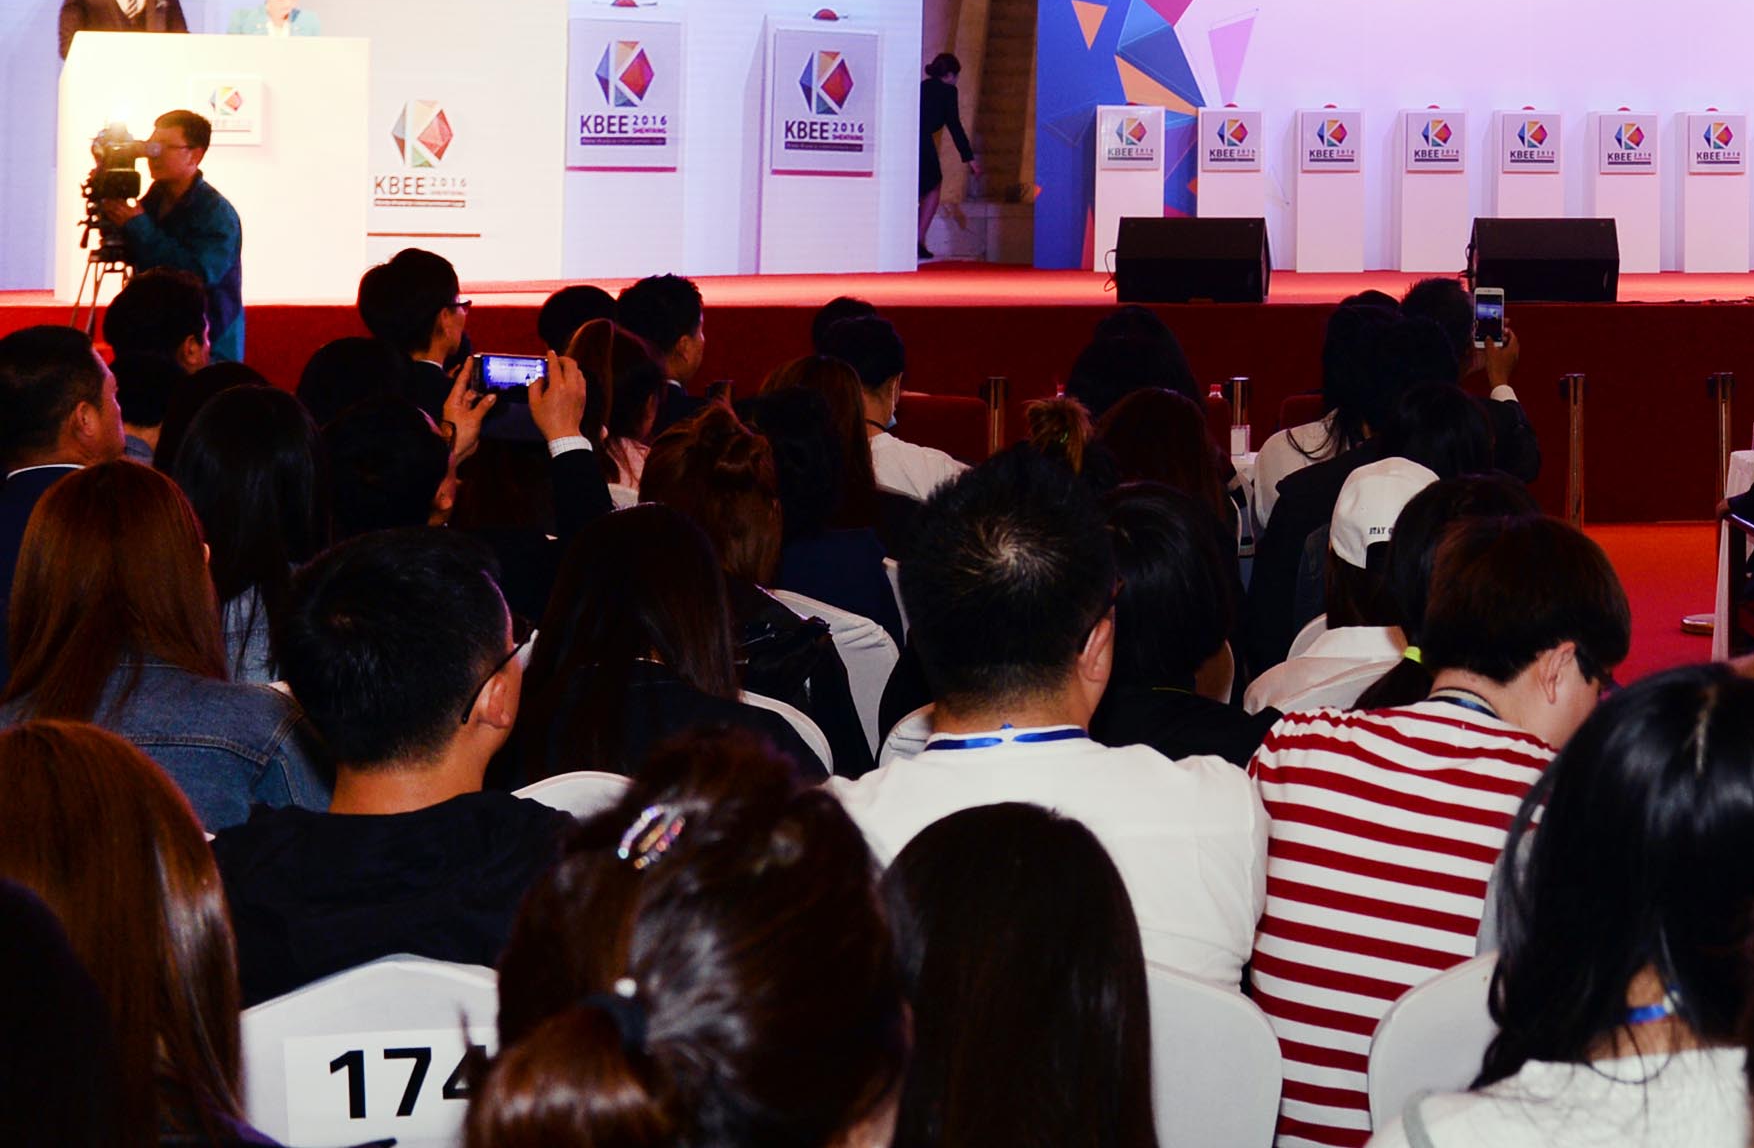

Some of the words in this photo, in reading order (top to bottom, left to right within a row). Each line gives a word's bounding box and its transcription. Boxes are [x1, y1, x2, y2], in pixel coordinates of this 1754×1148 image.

[580, 115, 629, 134] KBEE
[632, 115, 667, 126] 2016
[784, 120, 829, 140] KBEE
[832, 122, 865, 133] 2016
[1108, 148, 1134, 157] KBEE
[1209, 149, 1235, 157] KBEE
[1309, 150, 1334, 158] KBEE
[1414, 150, 1440, 158] KBEE
[1510, 150, 1535, 159] KBEE
[1607, 152, 1632, 161] KBEE
[1696, 152, 1721, 160] KBEE
[374, 176, 425, 195] KBEE
[330, 1044, 486, 1119] 174
